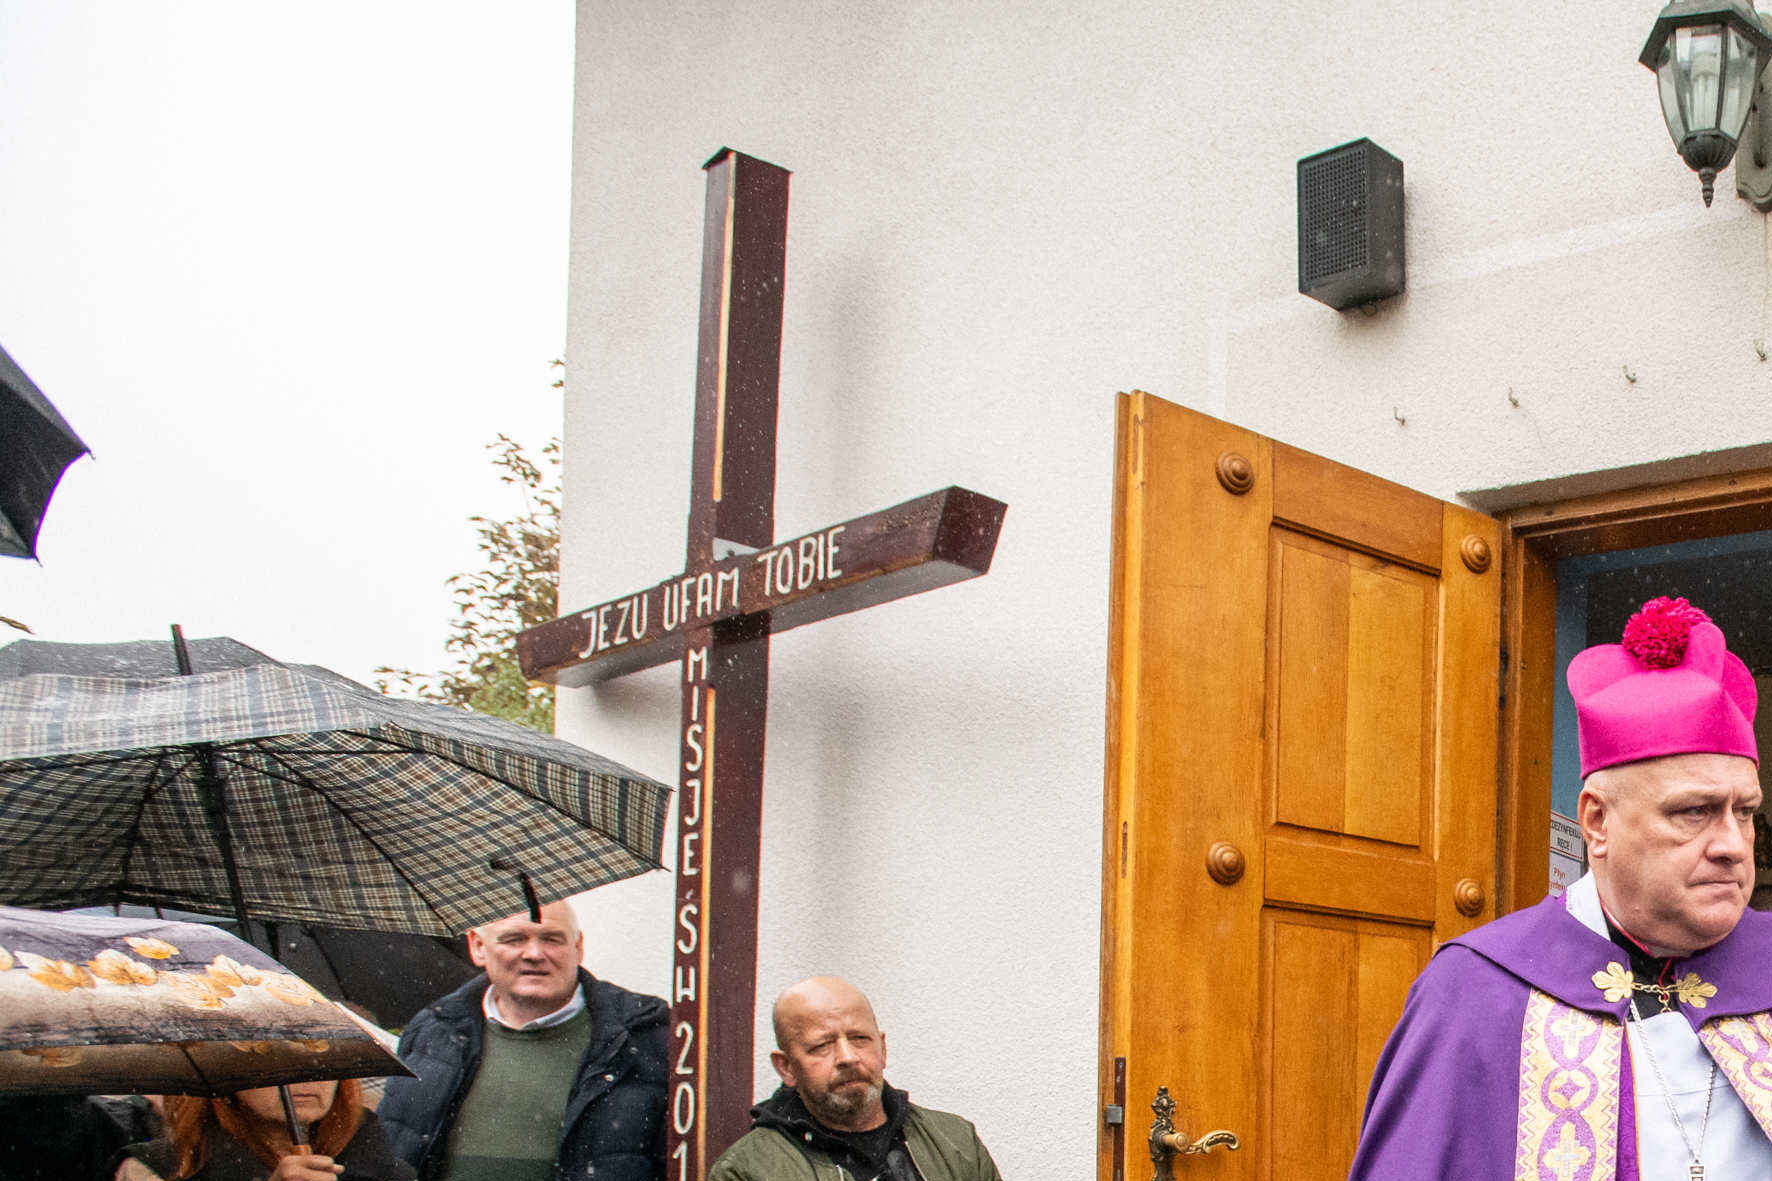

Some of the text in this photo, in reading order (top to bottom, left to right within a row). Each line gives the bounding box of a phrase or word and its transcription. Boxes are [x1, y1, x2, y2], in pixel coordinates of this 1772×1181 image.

[578, 524, 847, 659] JEZU UFAM TOBIE
[682, 645, 708, 877] MISJE
[1557, 837, 1570, 850] RĘCE
